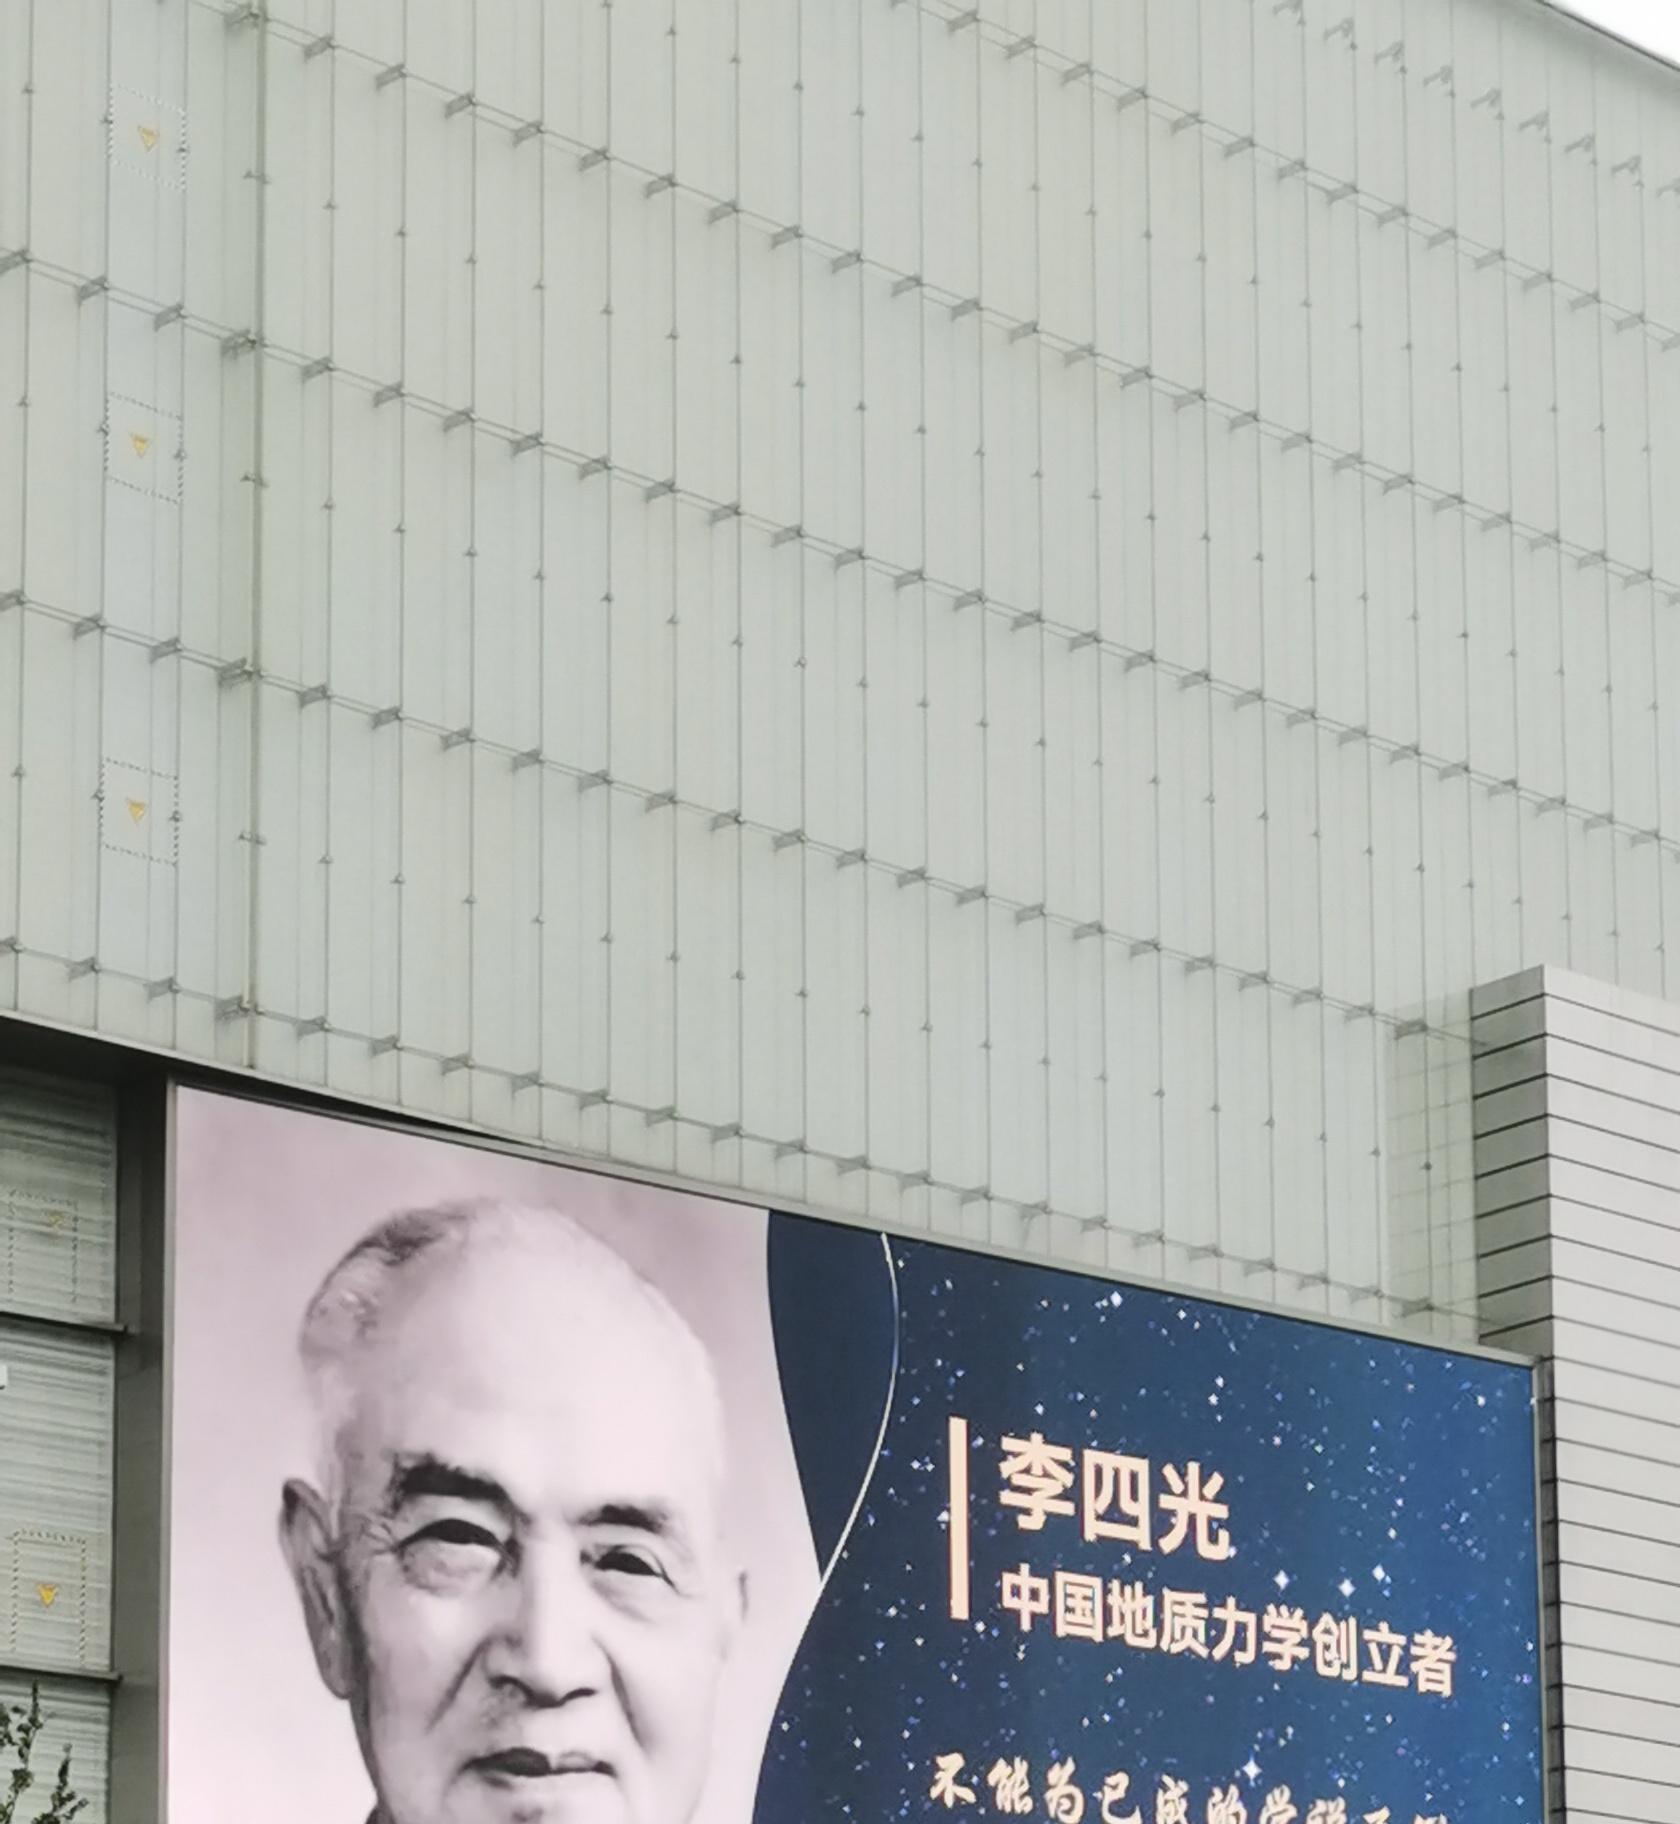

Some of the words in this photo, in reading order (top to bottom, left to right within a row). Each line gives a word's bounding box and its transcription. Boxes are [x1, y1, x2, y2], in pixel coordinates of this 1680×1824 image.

[999, 1432, 1231, 1562] 李四光
[1000, 1563, 1458, 1697] 中国地质力学创立者
